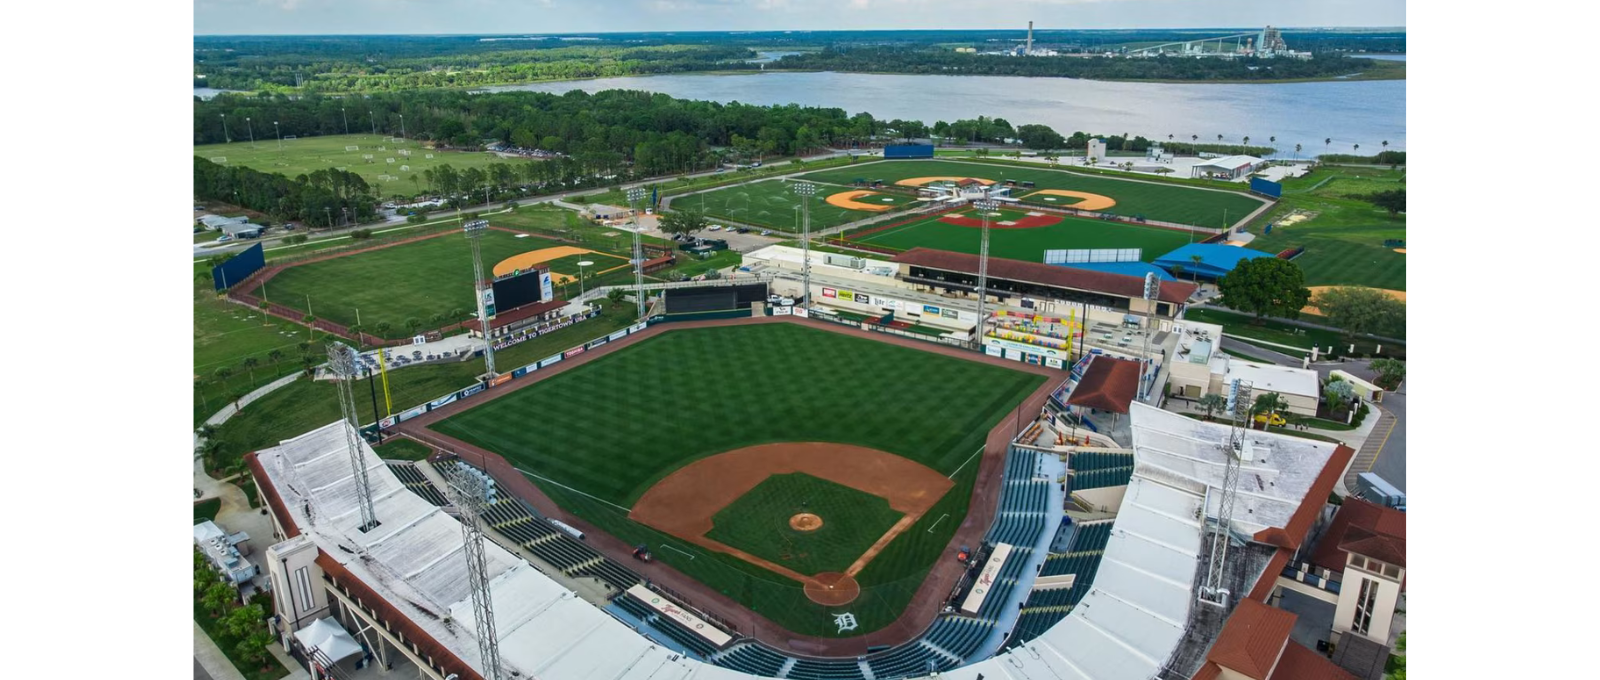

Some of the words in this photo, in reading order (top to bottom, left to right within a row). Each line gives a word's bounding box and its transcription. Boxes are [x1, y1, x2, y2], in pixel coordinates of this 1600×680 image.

[493, 336, 527, 351] WELCOME
[538, 320, 573, 336] TIGERTOWN
[575, 315, 587, 323] USA
[566, 347, 583, 356] TOSHIBA
[831, 612, 858, 634] D
